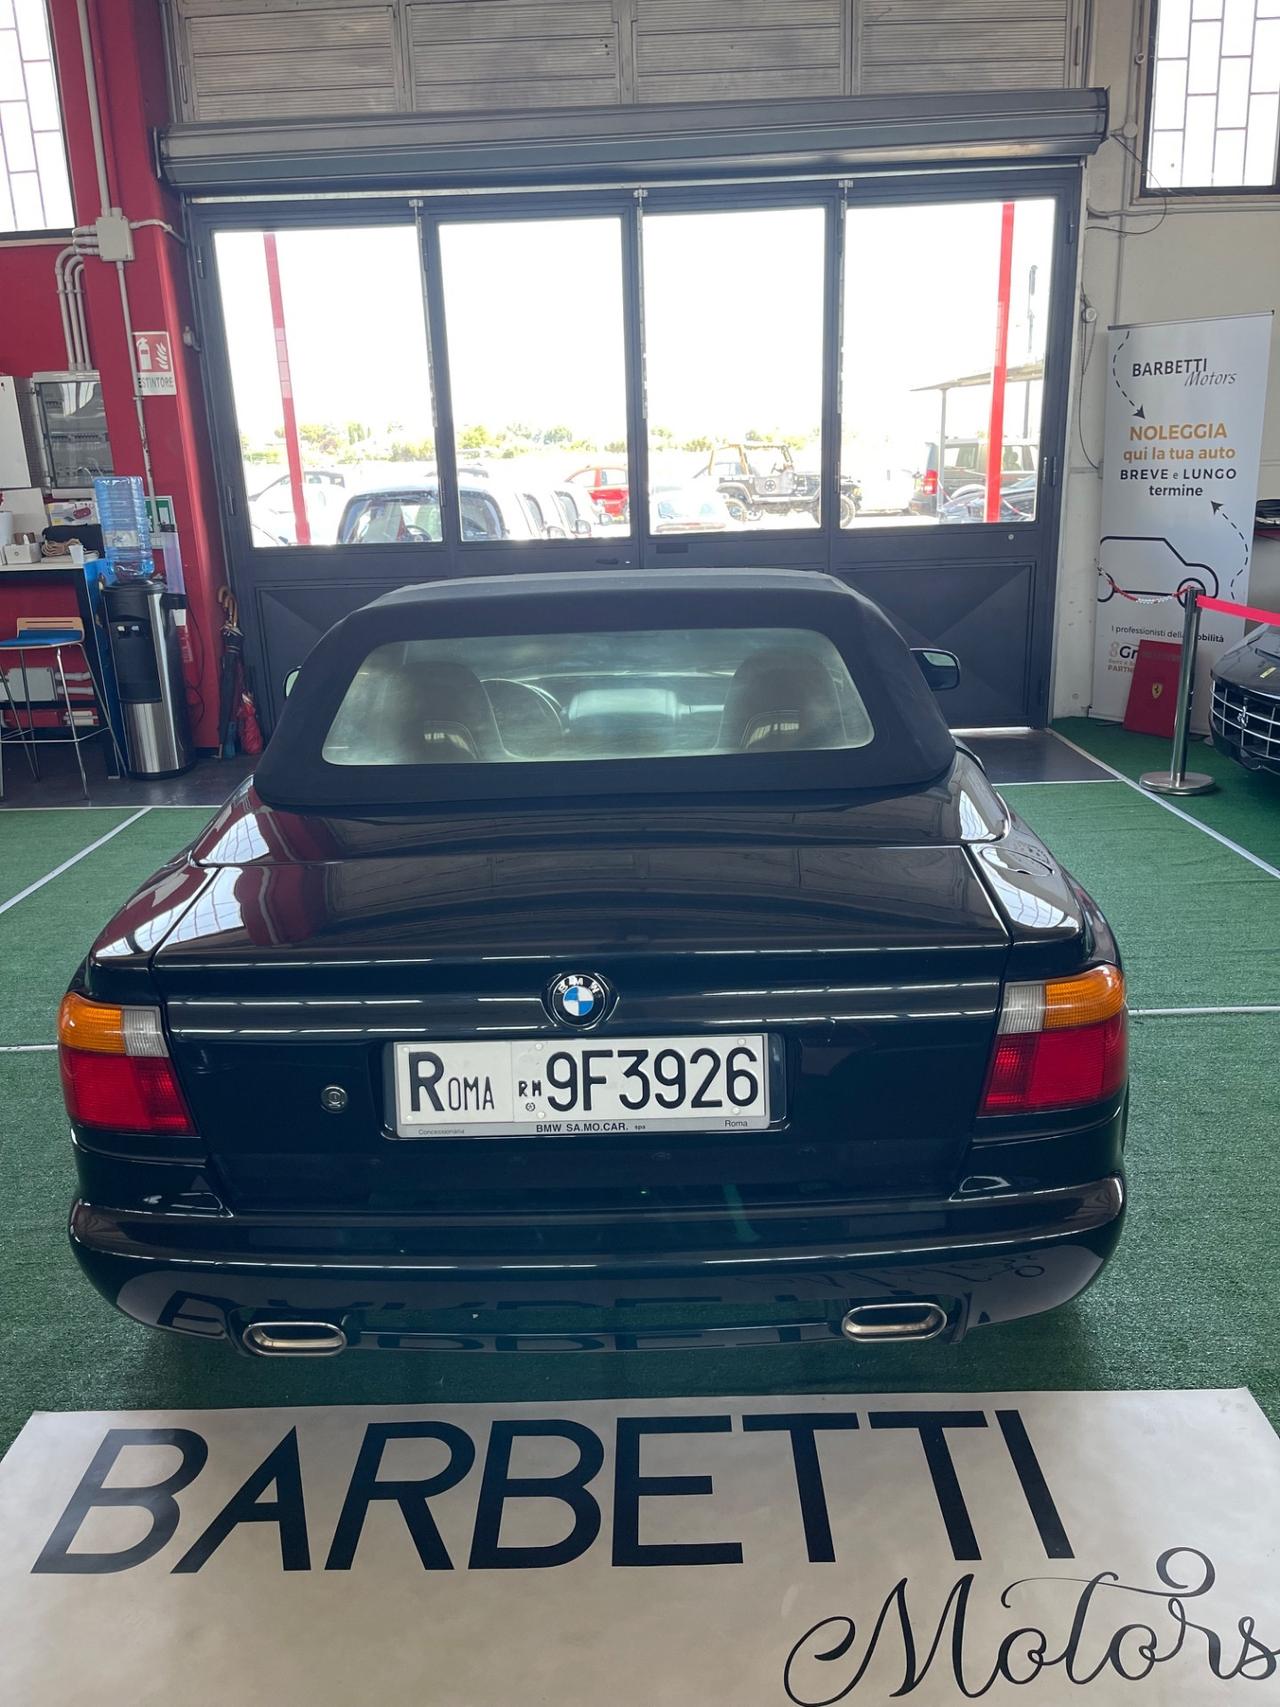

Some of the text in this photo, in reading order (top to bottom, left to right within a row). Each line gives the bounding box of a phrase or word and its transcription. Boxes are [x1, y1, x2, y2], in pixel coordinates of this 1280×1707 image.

[1132, 358, 1208, 377] BARBETTI
[1184, 371, 1237, 387] Motors
[1130, 423, 1228, 441] NOLEGGIA
[1123, 446, 1236, 463] qui la tua auto
[1120, 468, 1237, 480] BREVE e LUNGO
[1149, 485, 1203, 496] termine
[1115, 626, 1166, 637] professionisti
[557, 975, 601, 994] BMW
[546, 1046, 759, 1112] 9F3926
[536, 1124, 562, 1133] BMW
[566, 1121, 629, 1132] SA.MO.CAR.
[724, 1120, 748, 1128] Roma
[30, 1410, 1075, 1574] BARBETTI
[784, 1546, 1280, 1707] Motors
